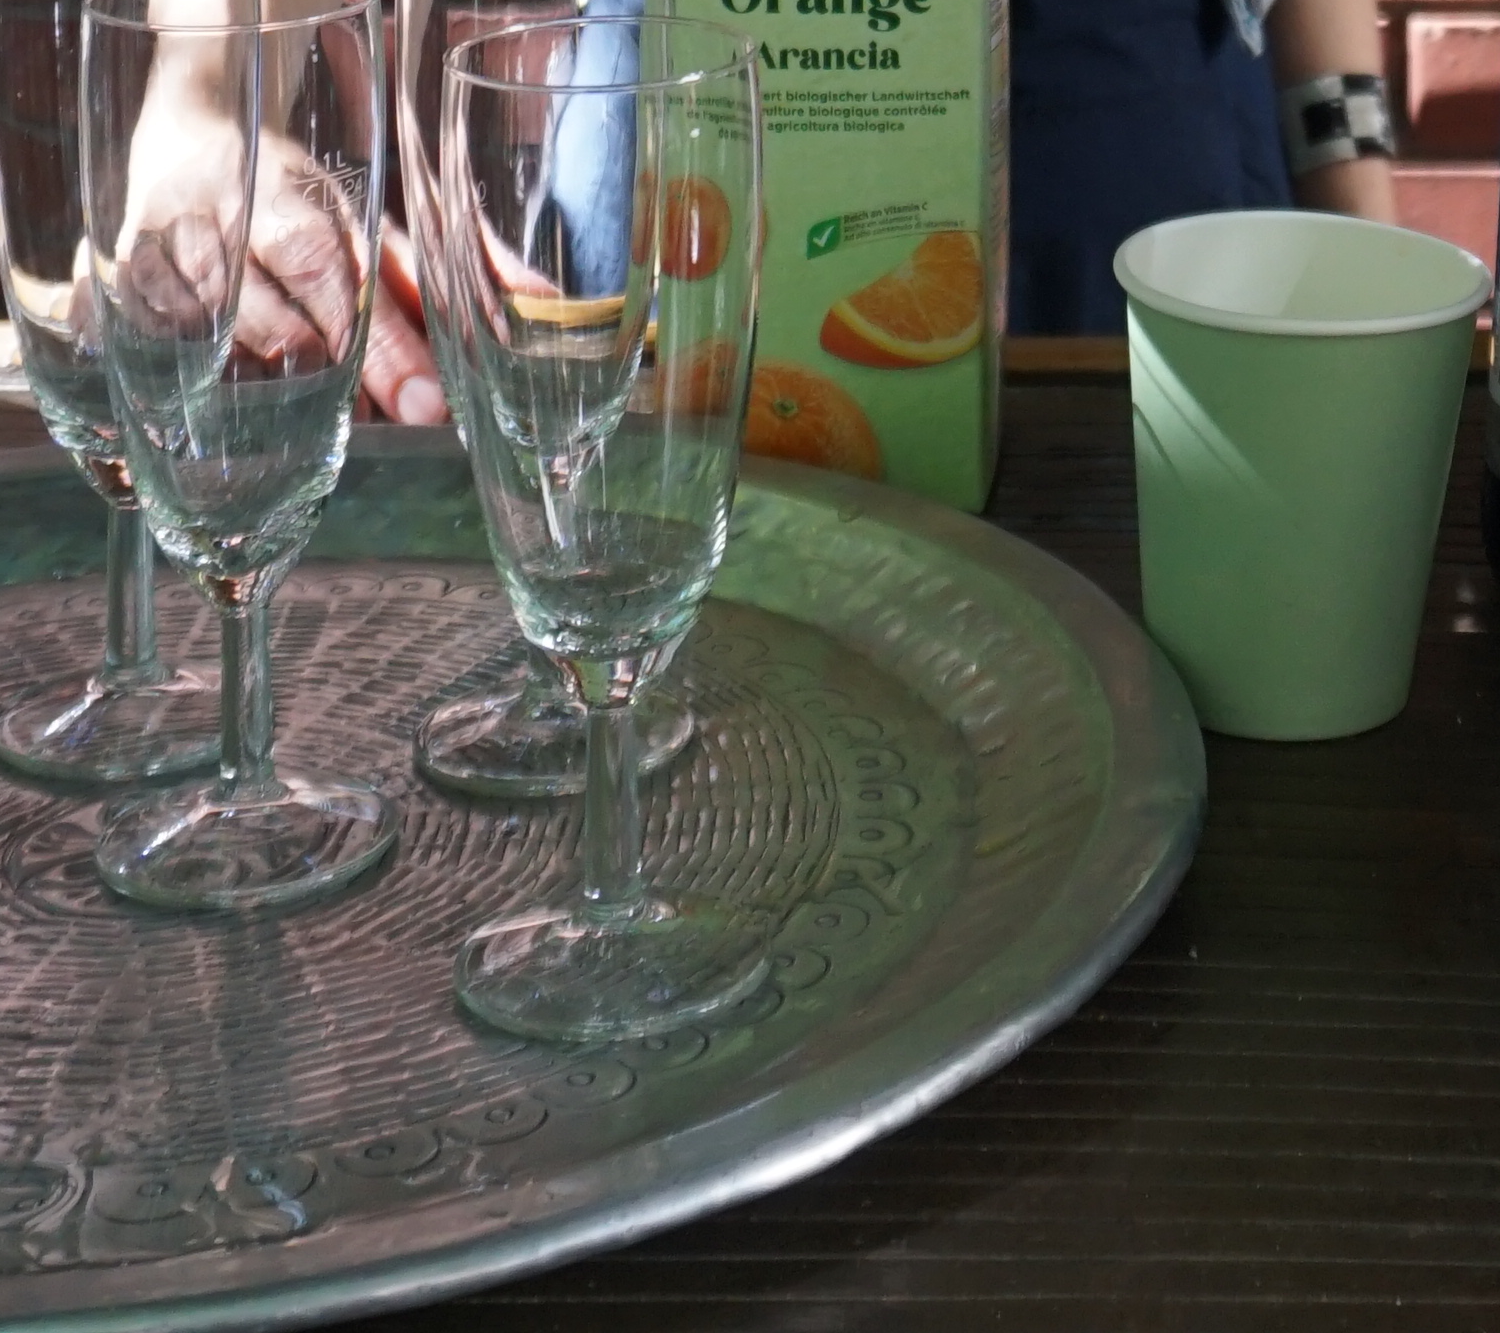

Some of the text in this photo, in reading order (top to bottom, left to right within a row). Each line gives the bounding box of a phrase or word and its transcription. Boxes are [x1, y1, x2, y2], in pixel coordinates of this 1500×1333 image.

[786, 90, 868, 104] biologischer
[872, 89, 970, 102] Landwirtschaft
[809, 105, 879, 119] biologique
[884, 104, 947, 116] contrôlée
[767, 120, 905, 133] agricoltura biologica
